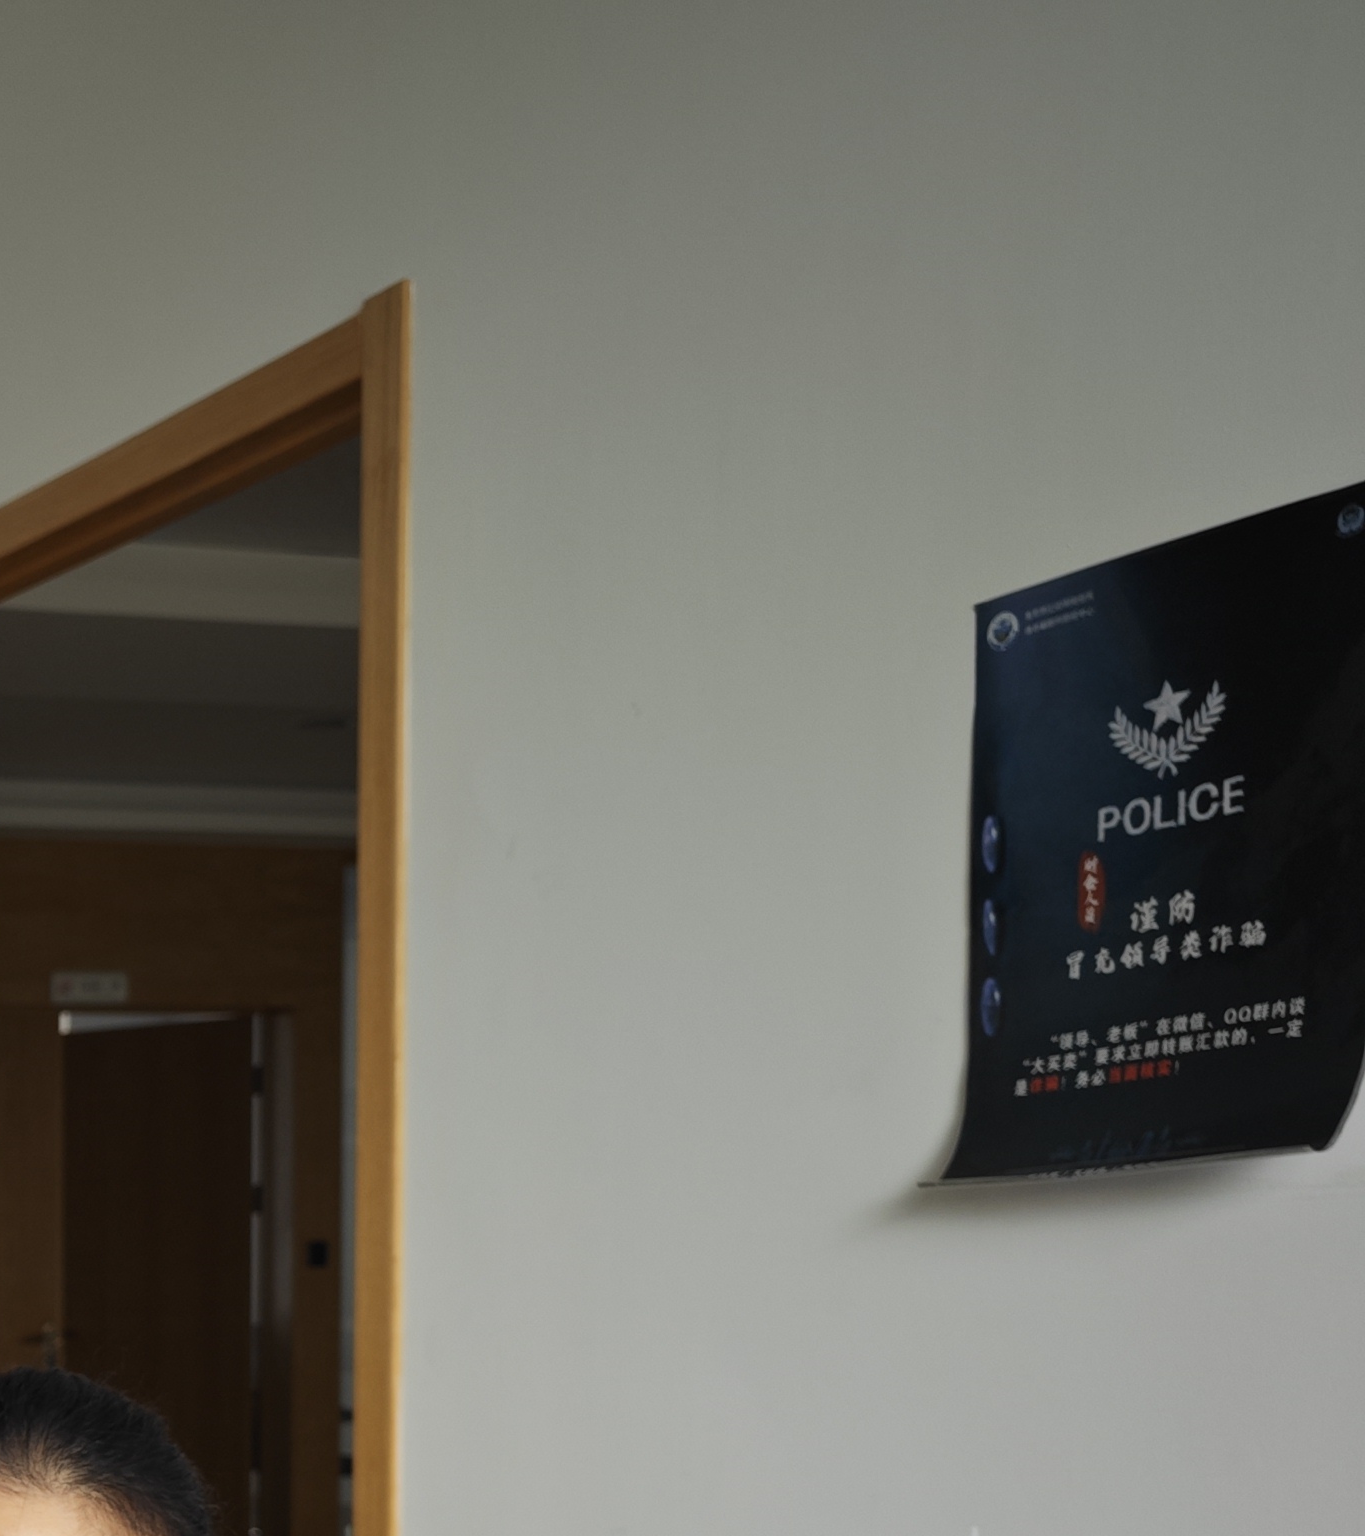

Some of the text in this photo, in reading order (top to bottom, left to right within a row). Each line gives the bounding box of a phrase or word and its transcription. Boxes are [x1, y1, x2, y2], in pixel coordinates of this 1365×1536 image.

[1096, 775, 1246, 842] POLICE
[1130, 889, 1197, 933] 谨防
[1065, 919, 1268, 981] 冒充领导类诈骗
